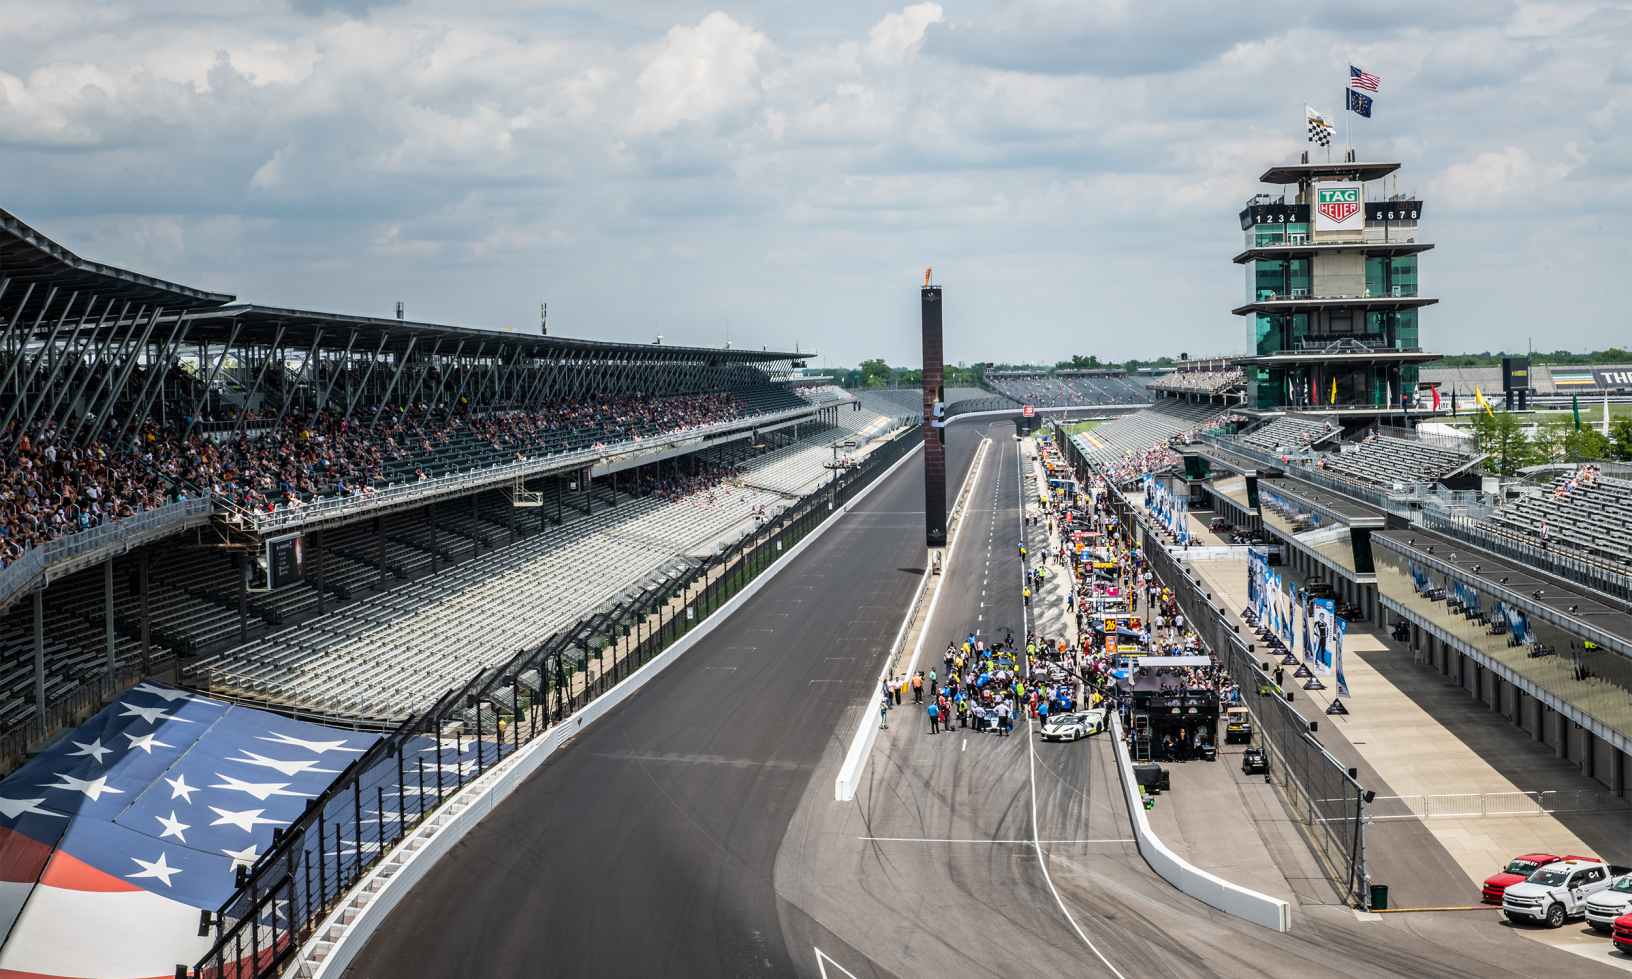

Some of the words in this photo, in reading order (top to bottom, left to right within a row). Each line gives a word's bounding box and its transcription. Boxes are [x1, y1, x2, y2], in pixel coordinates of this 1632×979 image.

[1322, 191, 1355, 201] TAG
[1321, 203, 1357, 220] HEUER
[1376, 211, 1383, 220] 5
[1388, 211, 1394, 220] 6
[1399, 211, 1406, 219] 7
[1411, 210, 1417, 219] 8
[1256, 215, 1261, 223] 1
[1267, 214, 1273, 223] 2
[1278, 214, 1284, 222] 3
[1289, 214, 1296, 222] 4
[1105, 620, 1115, 630] 26
[1512, 859, 1538, 867] CHEVROLET
[1588, 871, 1600, 879] C-1
